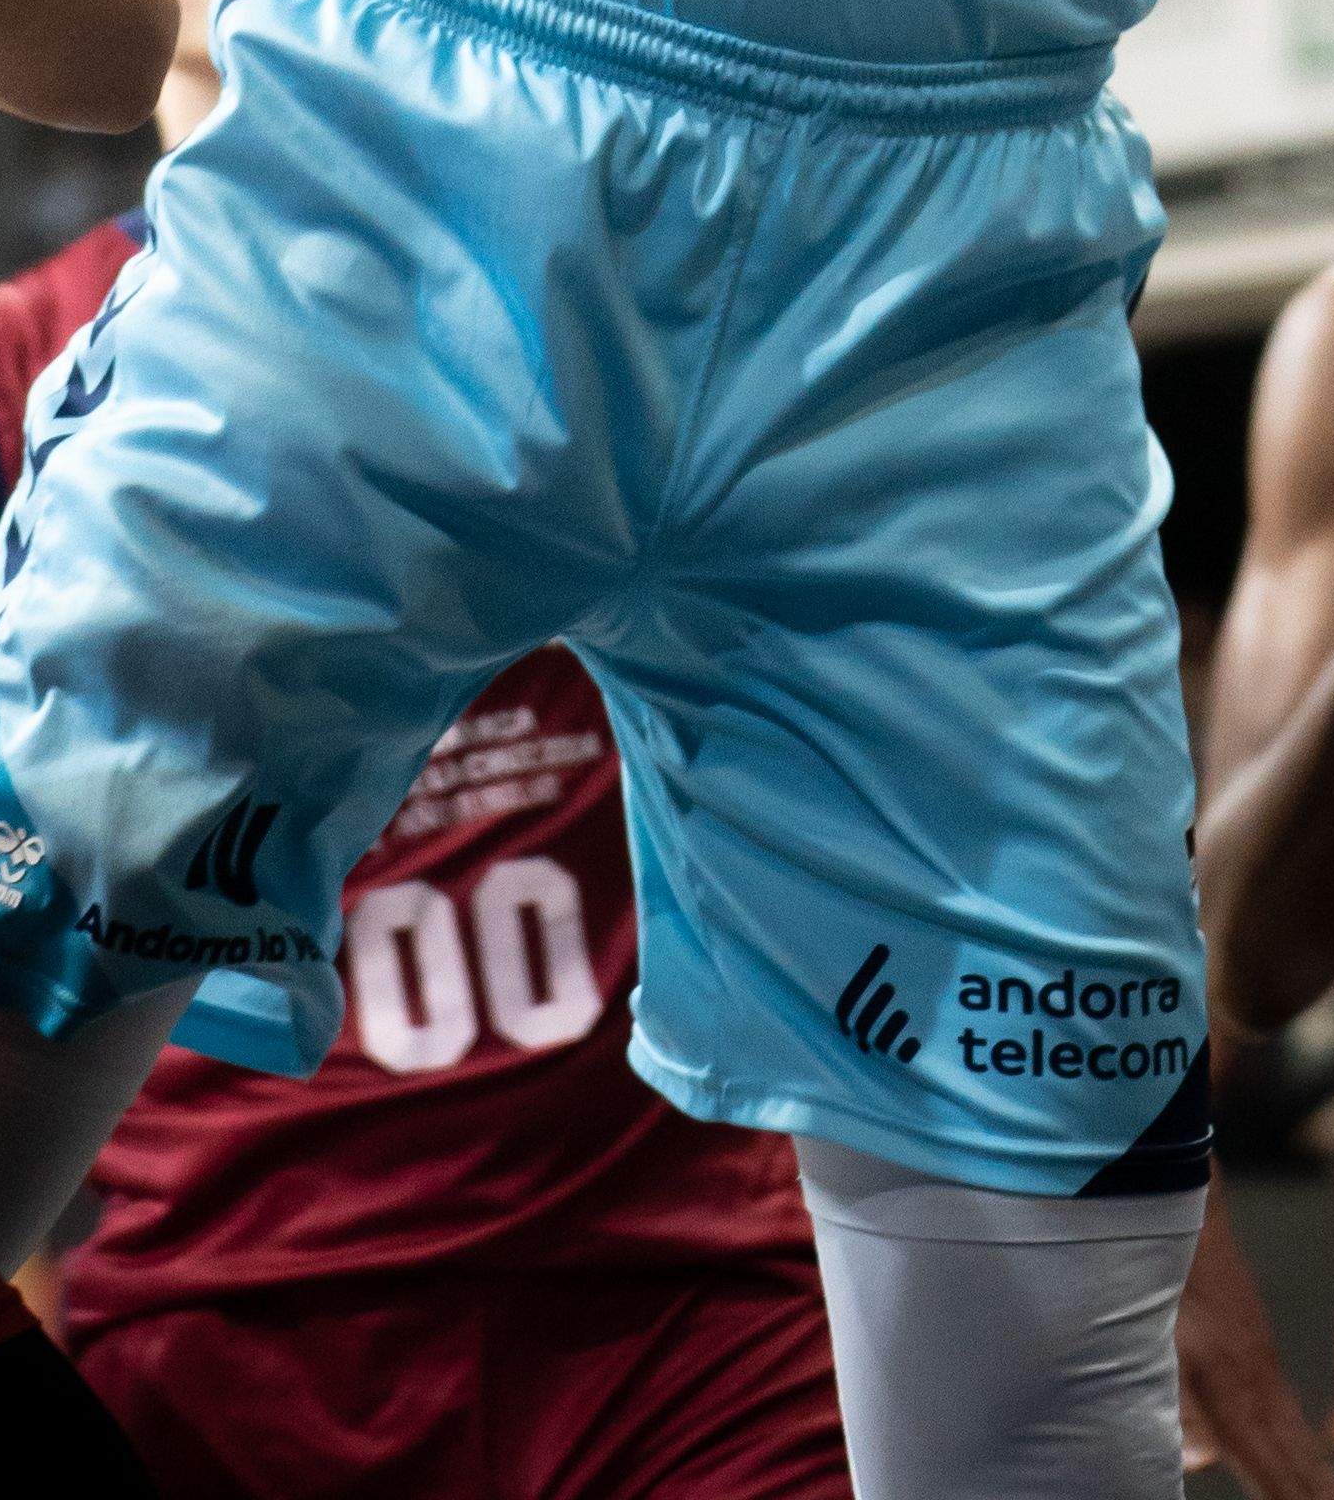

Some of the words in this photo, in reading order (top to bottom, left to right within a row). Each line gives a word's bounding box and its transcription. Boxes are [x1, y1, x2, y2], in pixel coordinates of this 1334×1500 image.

[74, 902, 251, 965] Andorra
[349, 856, 604, 1074] 00
[957, 969, 1182, 1022] andorra
[956, 1027, 1190, 1081] telecom
